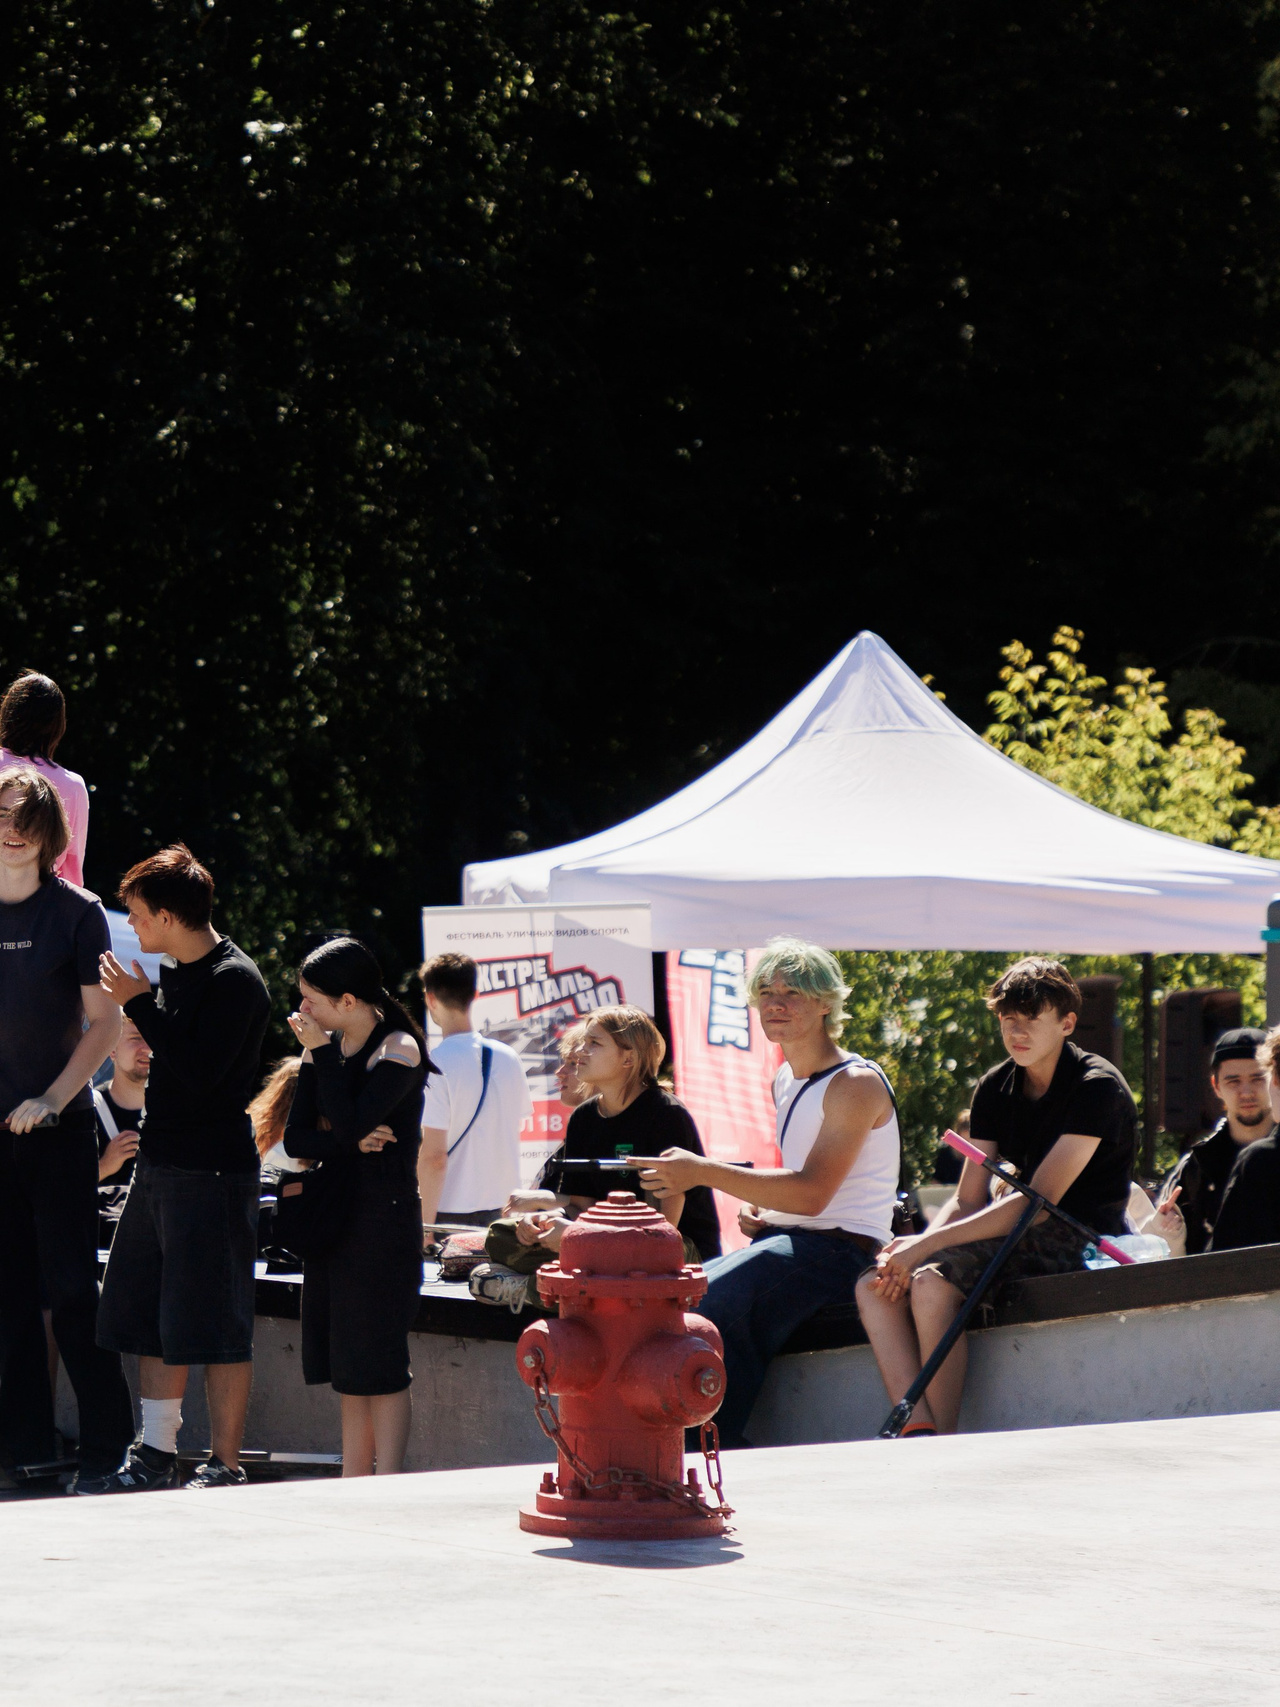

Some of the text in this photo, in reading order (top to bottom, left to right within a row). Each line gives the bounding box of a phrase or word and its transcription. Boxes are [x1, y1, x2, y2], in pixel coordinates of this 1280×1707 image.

[446, 927, 630, 940] ФЕСТИВАЛЬ УЛИЧНЫХ ВИДОВ СПОРТА
[477, 958, 548, 992] КСТРЕ
[522, 971, 594, 1012] МАЛЬ
[538, 1115, 563, 1132] 18
